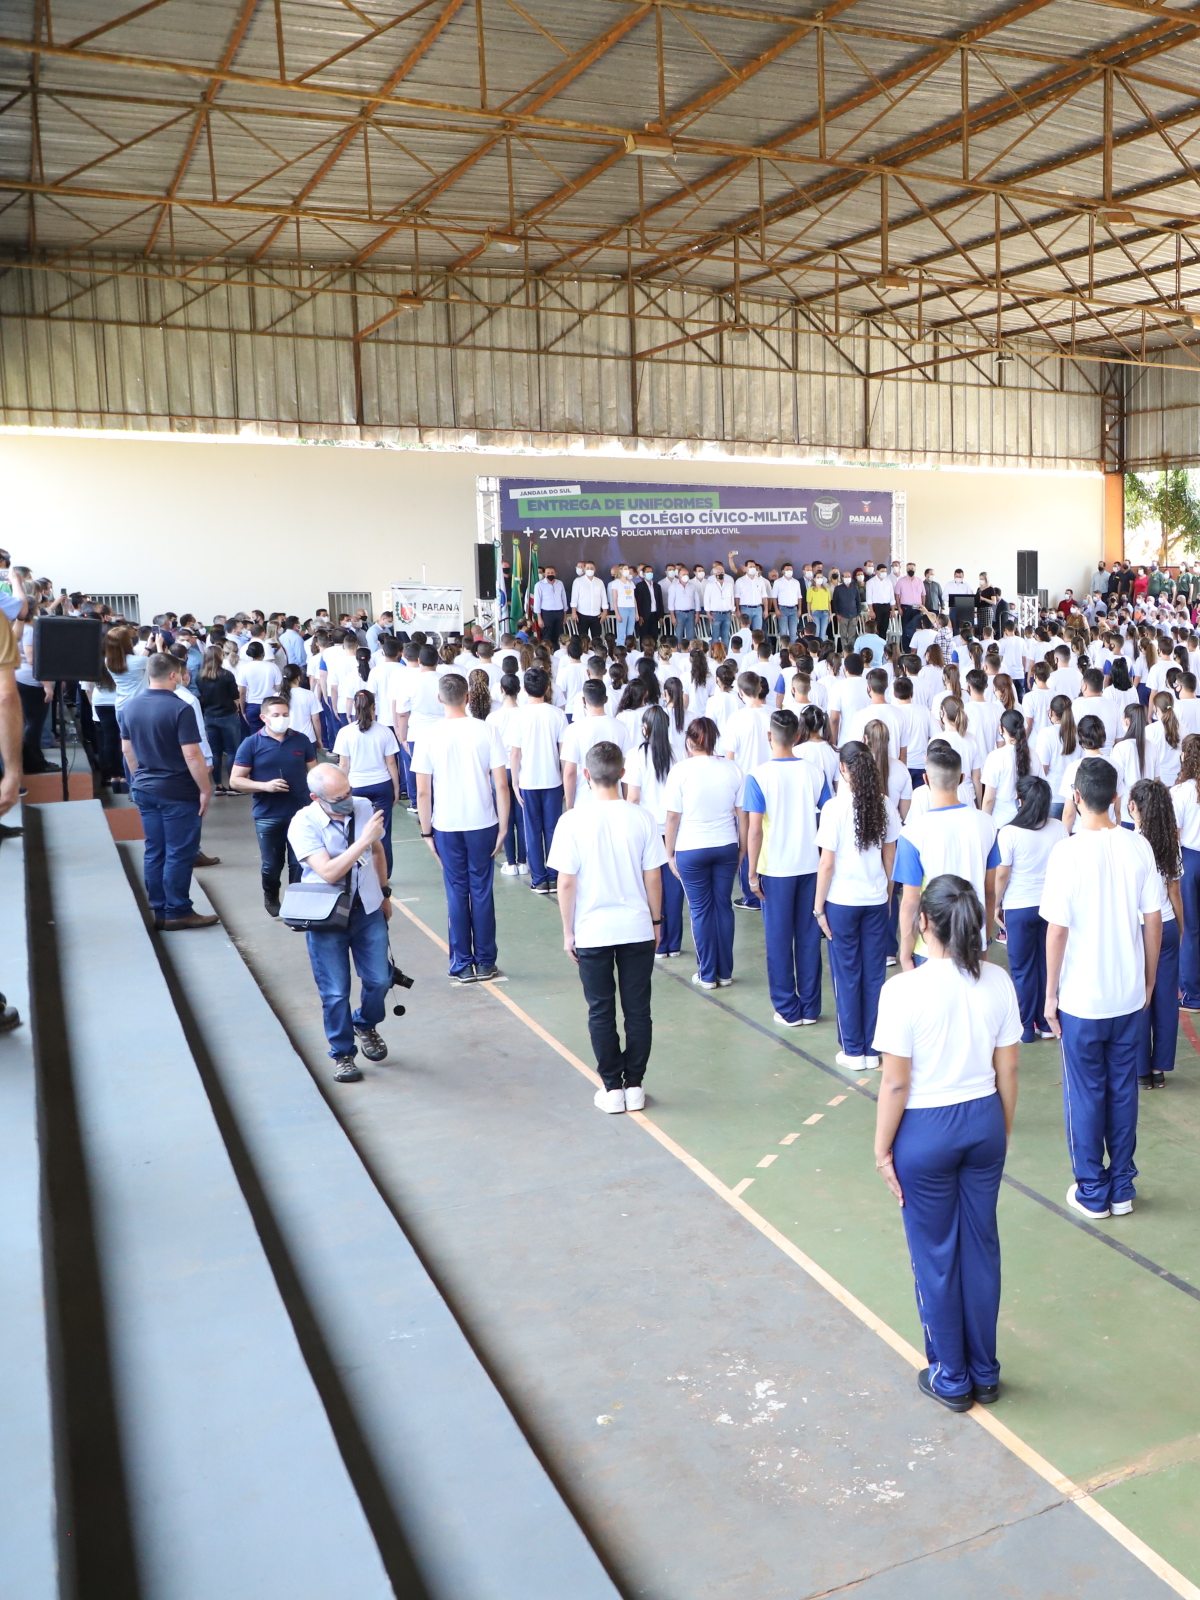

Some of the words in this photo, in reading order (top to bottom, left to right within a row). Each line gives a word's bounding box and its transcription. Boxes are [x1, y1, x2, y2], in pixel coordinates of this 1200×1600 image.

[527, 499, 602, 511] ENTREGA
[605, 498, 625, 510] DE
[628, 497, 713, 510] UNIFORMES
[629, 510, 695, 525] COLÉGIO
[698, 509, 807, 523] CÍVICO-MILITAR
[849, 515, 883, 523] PARANÁ
[539, 528, 548, 539] 2
[551, 526, 619, 538] VIATURAS
[621, 528, 652, 537] POLÍCIA
[653, 528, 683, 536] MILITAR
[691, 527, 720, 535] POLÍCIA
[422, 602, 460, 611] PARANÁ
